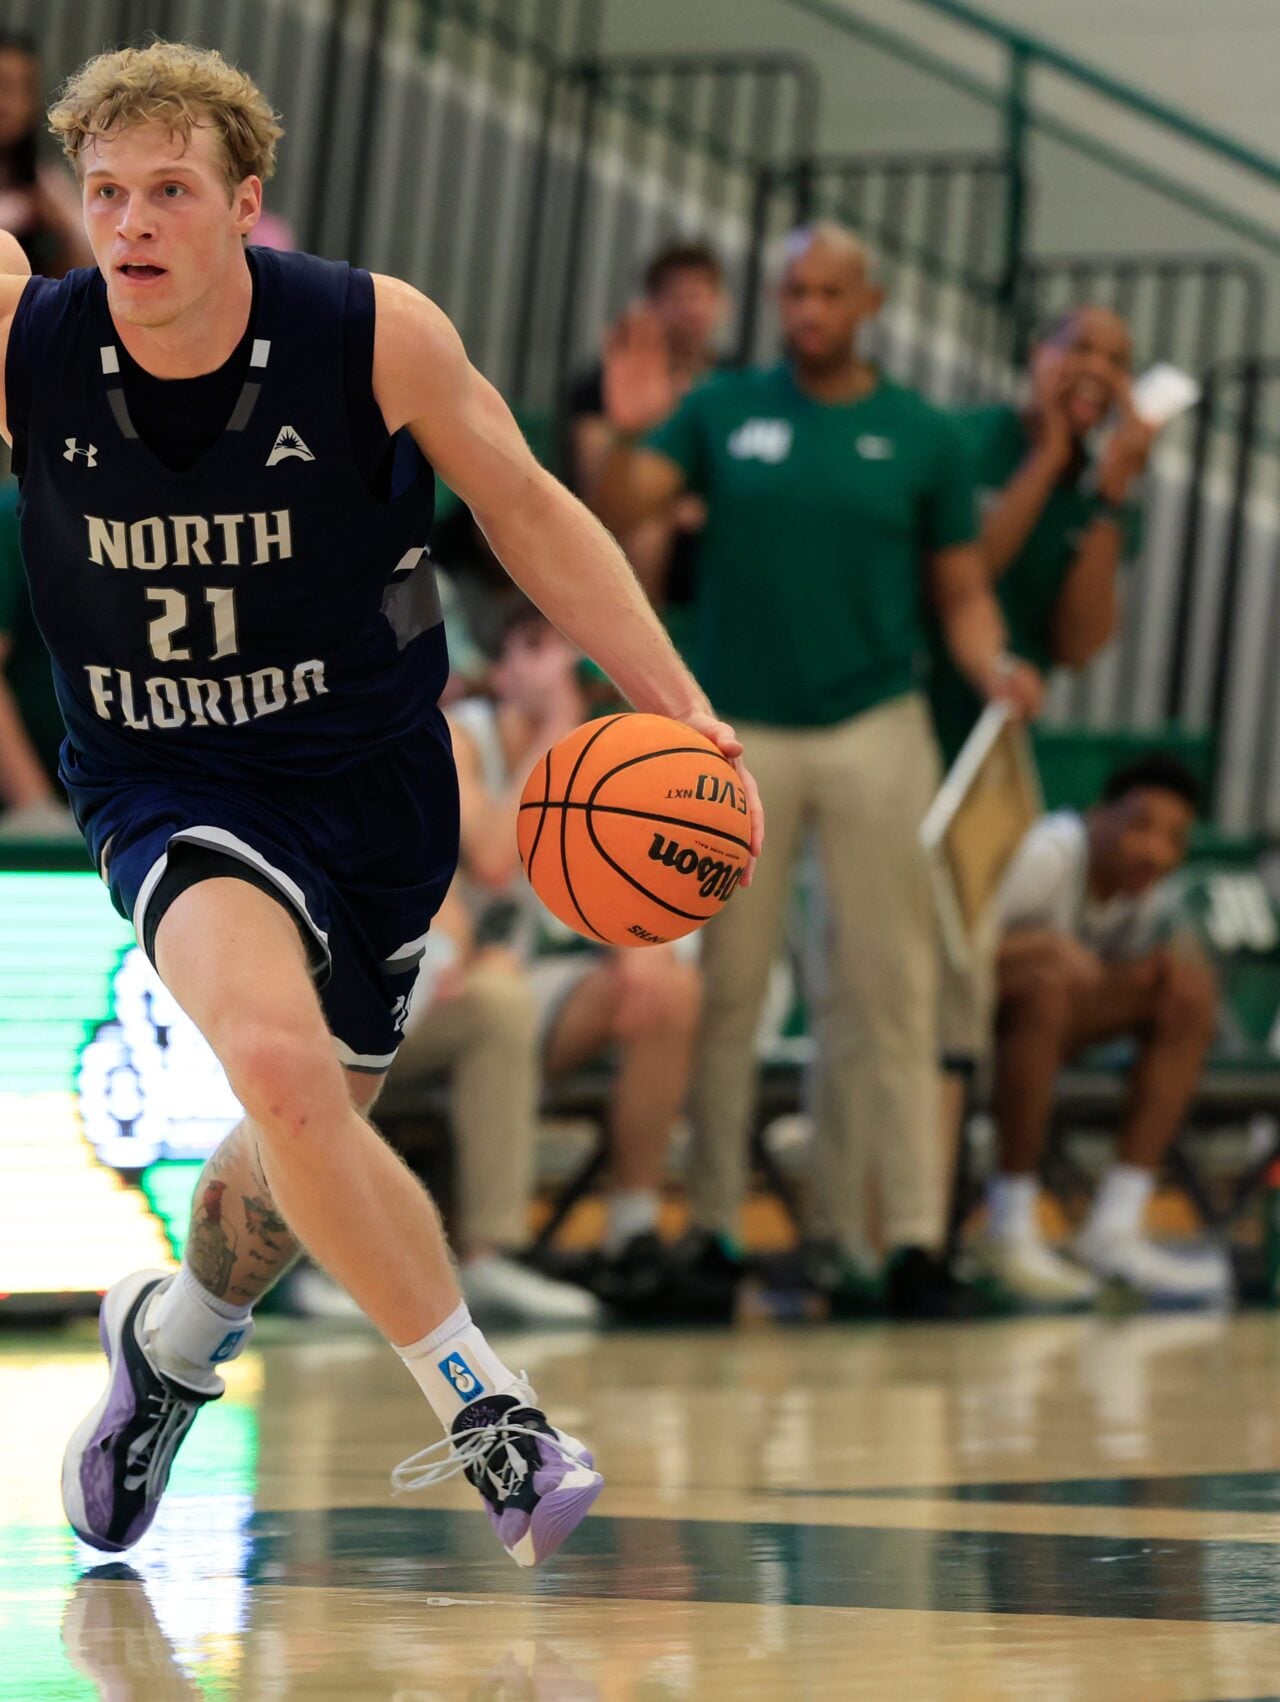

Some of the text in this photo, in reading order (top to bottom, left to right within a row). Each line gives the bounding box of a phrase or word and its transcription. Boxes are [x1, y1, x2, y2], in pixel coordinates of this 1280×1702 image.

[83, 509, 293, 570] NORTH
[144, 587, 239, 662] 21
[83, 659, 330, 730] FLORIDA
[664, 789, 693, 799] NXT
